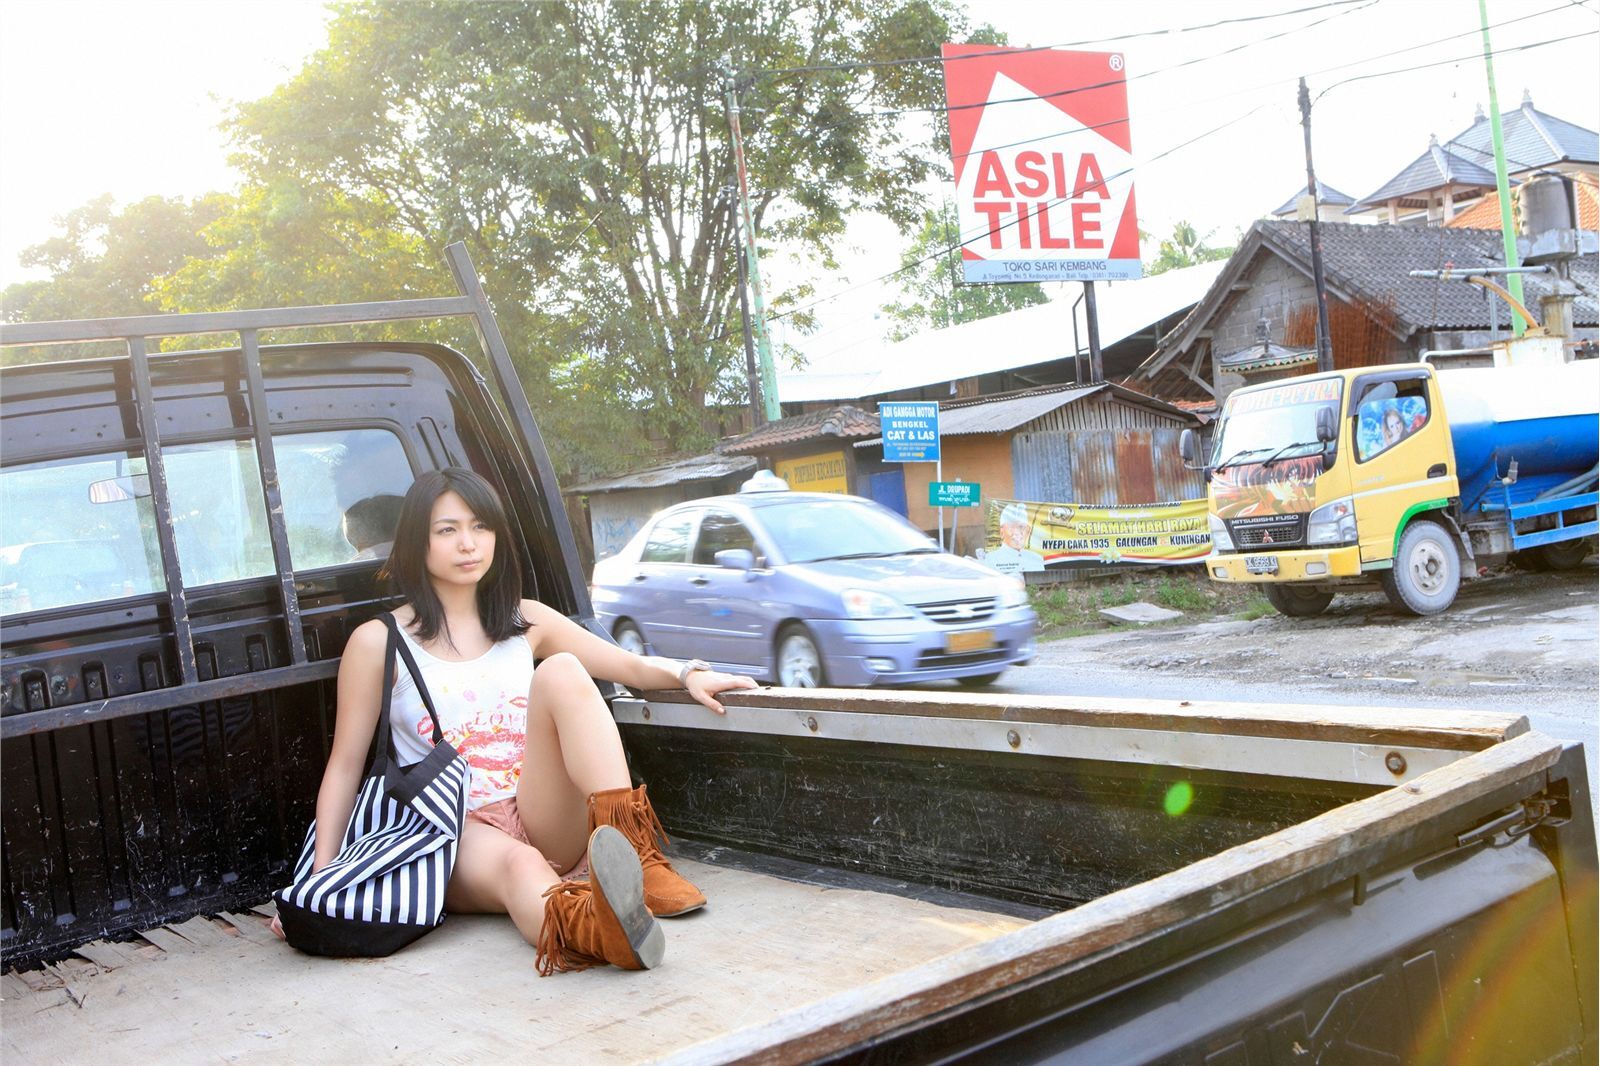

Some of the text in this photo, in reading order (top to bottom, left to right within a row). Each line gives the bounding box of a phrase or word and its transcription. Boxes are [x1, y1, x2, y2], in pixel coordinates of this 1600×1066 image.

[973, 150, 1111, 200] ASIA
[974, 202, 1104, 249] TILE
[1003, 261, 1106, 271] TOKO SARI KEMBANG
[916, 406, 935, 418] MOTOR
[892, 421, 928, 429] BENGKEL
[887, 431, 935, 440] CAT & LAS
[1078, 518, 1201, 535] SELAMAT HARI RAYA
[1231, 517, 1273, 525] MITSUBISHI
[1042, 540, 1065, 550] NYEPI
[1067, 539, 1088, 549] CAKA
[1091, 538, 1110, 548] 1935
[1116, 537, 1158, 548] GALUNGAN
[1170, 533, 1211, 545] KUNINGAN
